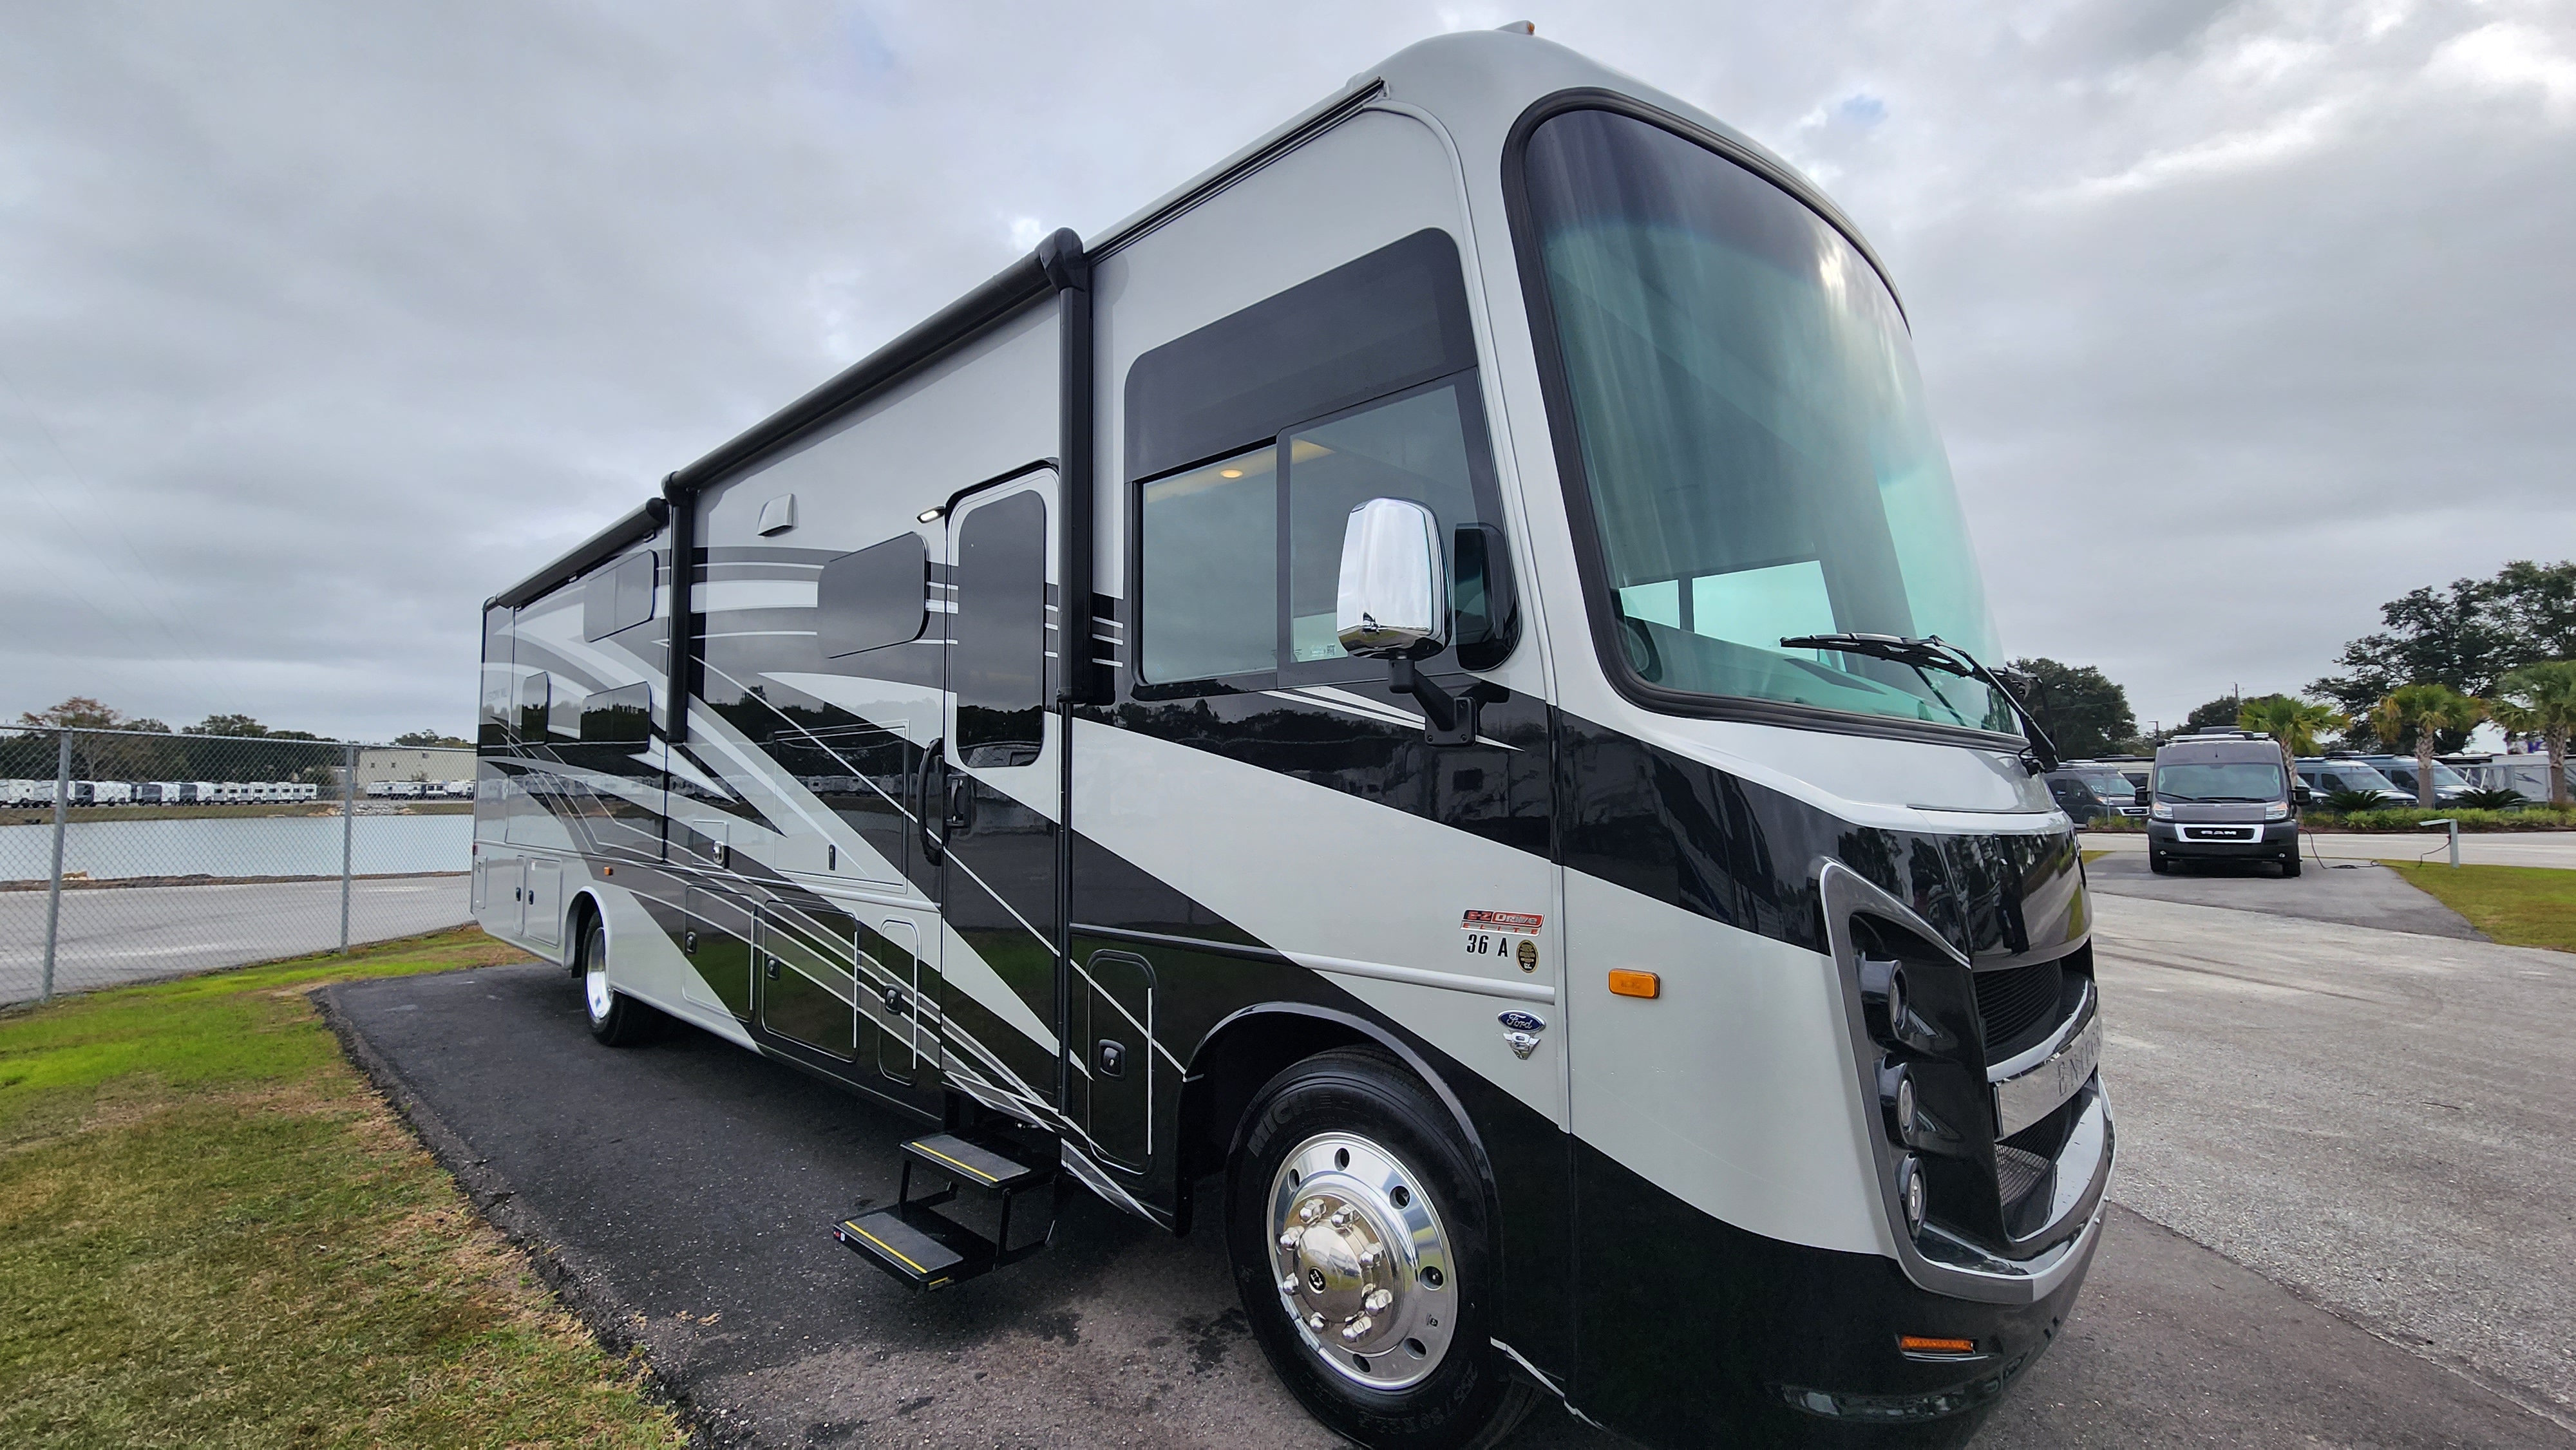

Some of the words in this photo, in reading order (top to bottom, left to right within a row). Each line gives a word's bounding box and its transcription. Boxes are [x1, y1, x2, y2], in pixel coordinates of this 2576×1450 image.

[1467, 910, 1492, 921] E-Z
[1495, 913, 1538, 925] Drive
[1463, 923, 1539, 935] ELITE
[1466, 934, 1490, 954] 36
[1497, 937, 1508, 957] A
[1506, 1013, 1533, 1030] Ford
